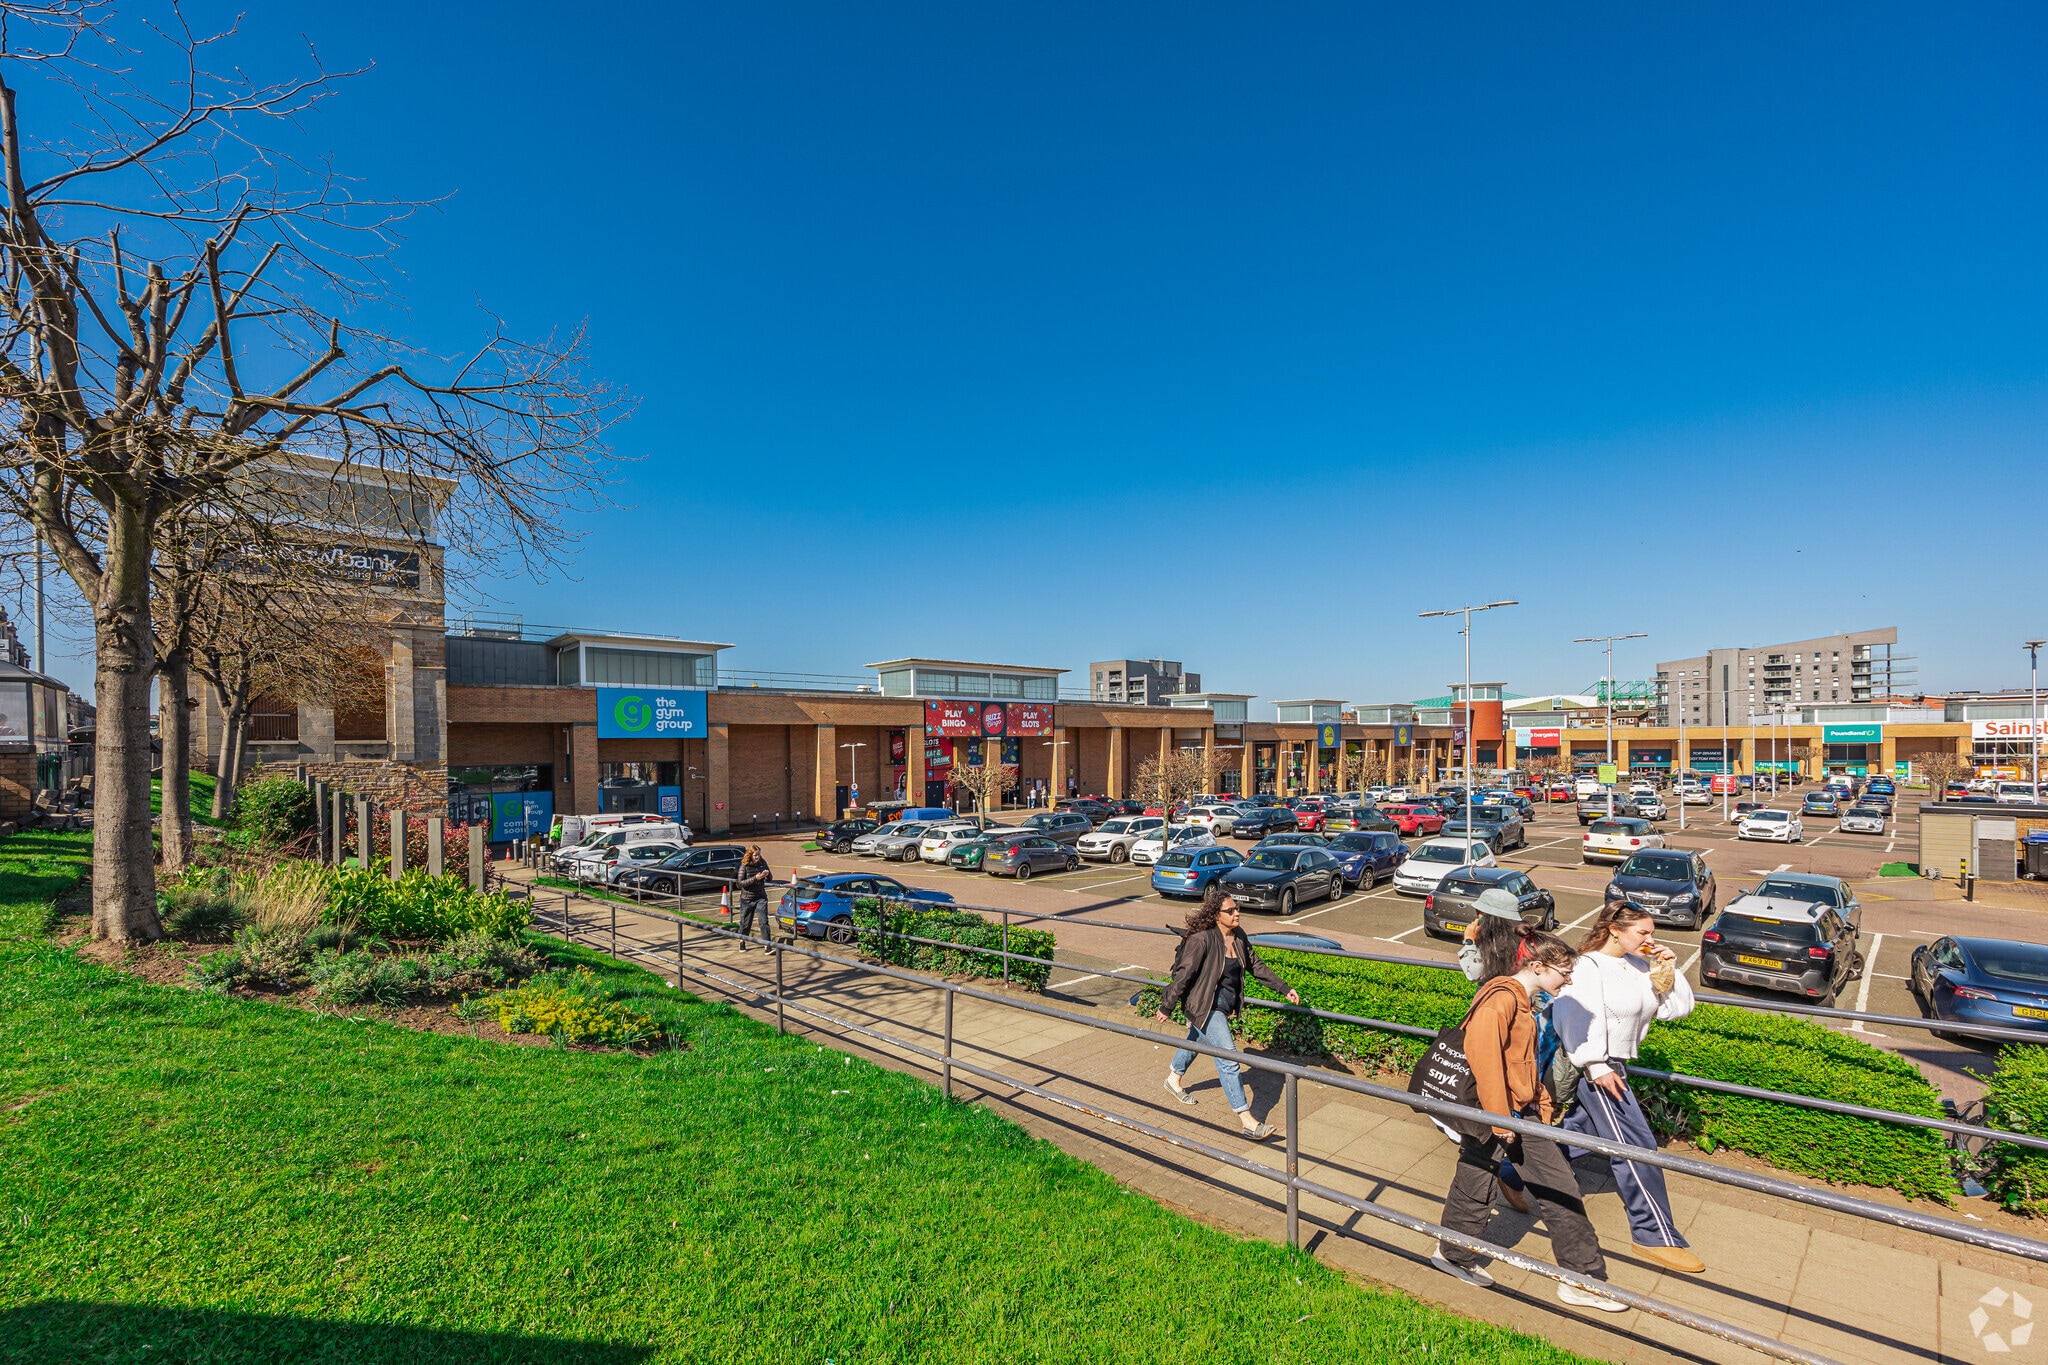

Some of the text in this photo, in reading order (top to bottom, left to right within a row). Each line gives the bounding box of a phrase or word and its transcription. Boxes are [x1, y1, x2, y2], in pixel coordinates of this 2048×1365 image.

[656, 697, 677, 707] the
[656, 708, 684, 719] gym
[945, 710, 963, 718] PLAY
[985, 712, 1002, 722] BUZZ
[656, 720, 693, 731] group
[942, 719, 966, 727] BINGO
[1021, 720, 1040, 728] SLOTS
[1534, 731, 1559, 739] bargains
[1428, 1068, 1459, 1088] snyk
